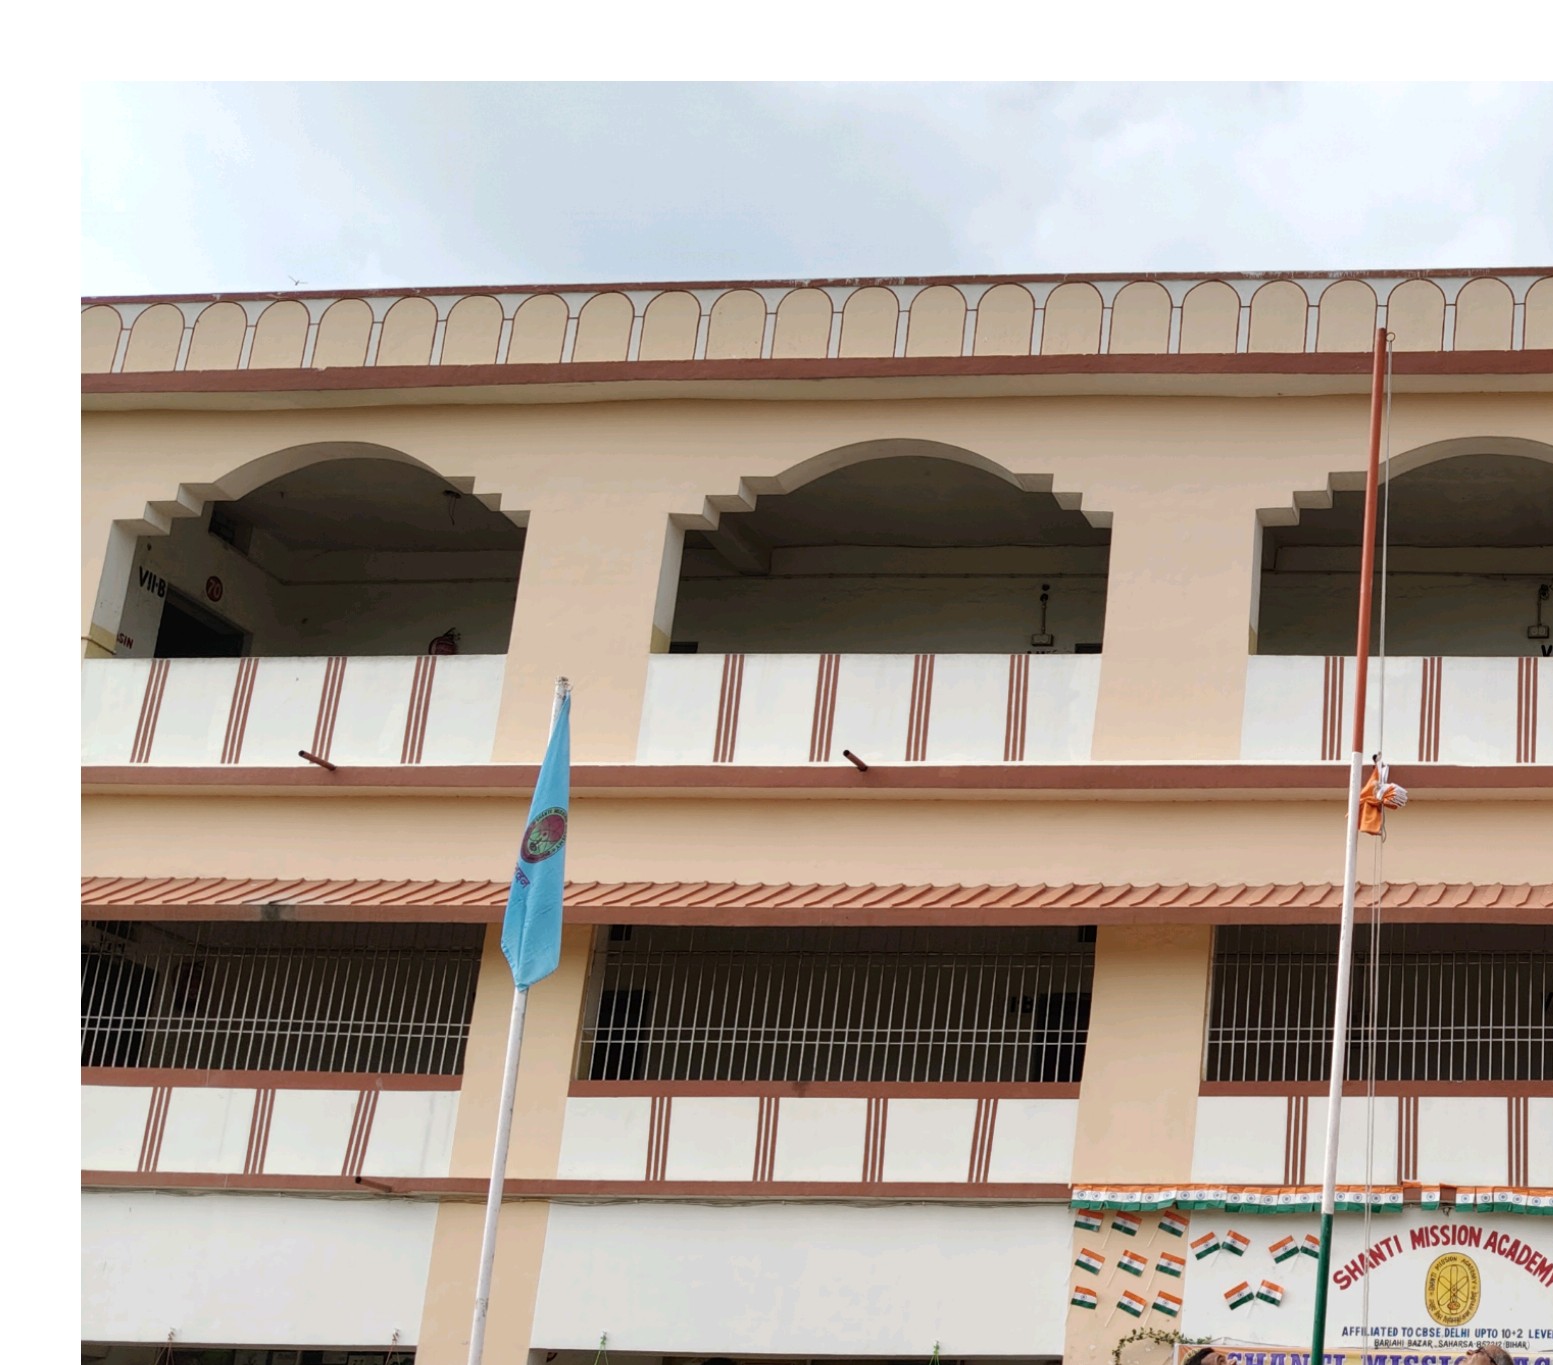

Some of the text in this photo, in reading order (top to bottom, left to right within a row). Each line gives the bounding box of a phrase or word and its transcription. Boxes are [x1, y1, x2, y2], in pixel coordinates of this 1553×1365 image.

[1333, 1235, 1404, 1291] SHANTI
[1410, 1224, 1482, 1250] MISSION
[1342, 1326, 1398, 1338] AFFILIATED
[1402, 1328, 1413, 1338] TO
[1475, 1329, 1498, 1339] UPTO
[1501, 1328, 1523, 1339] 10+2
[1374, 1339, 1405, 1349] BARIAHI
